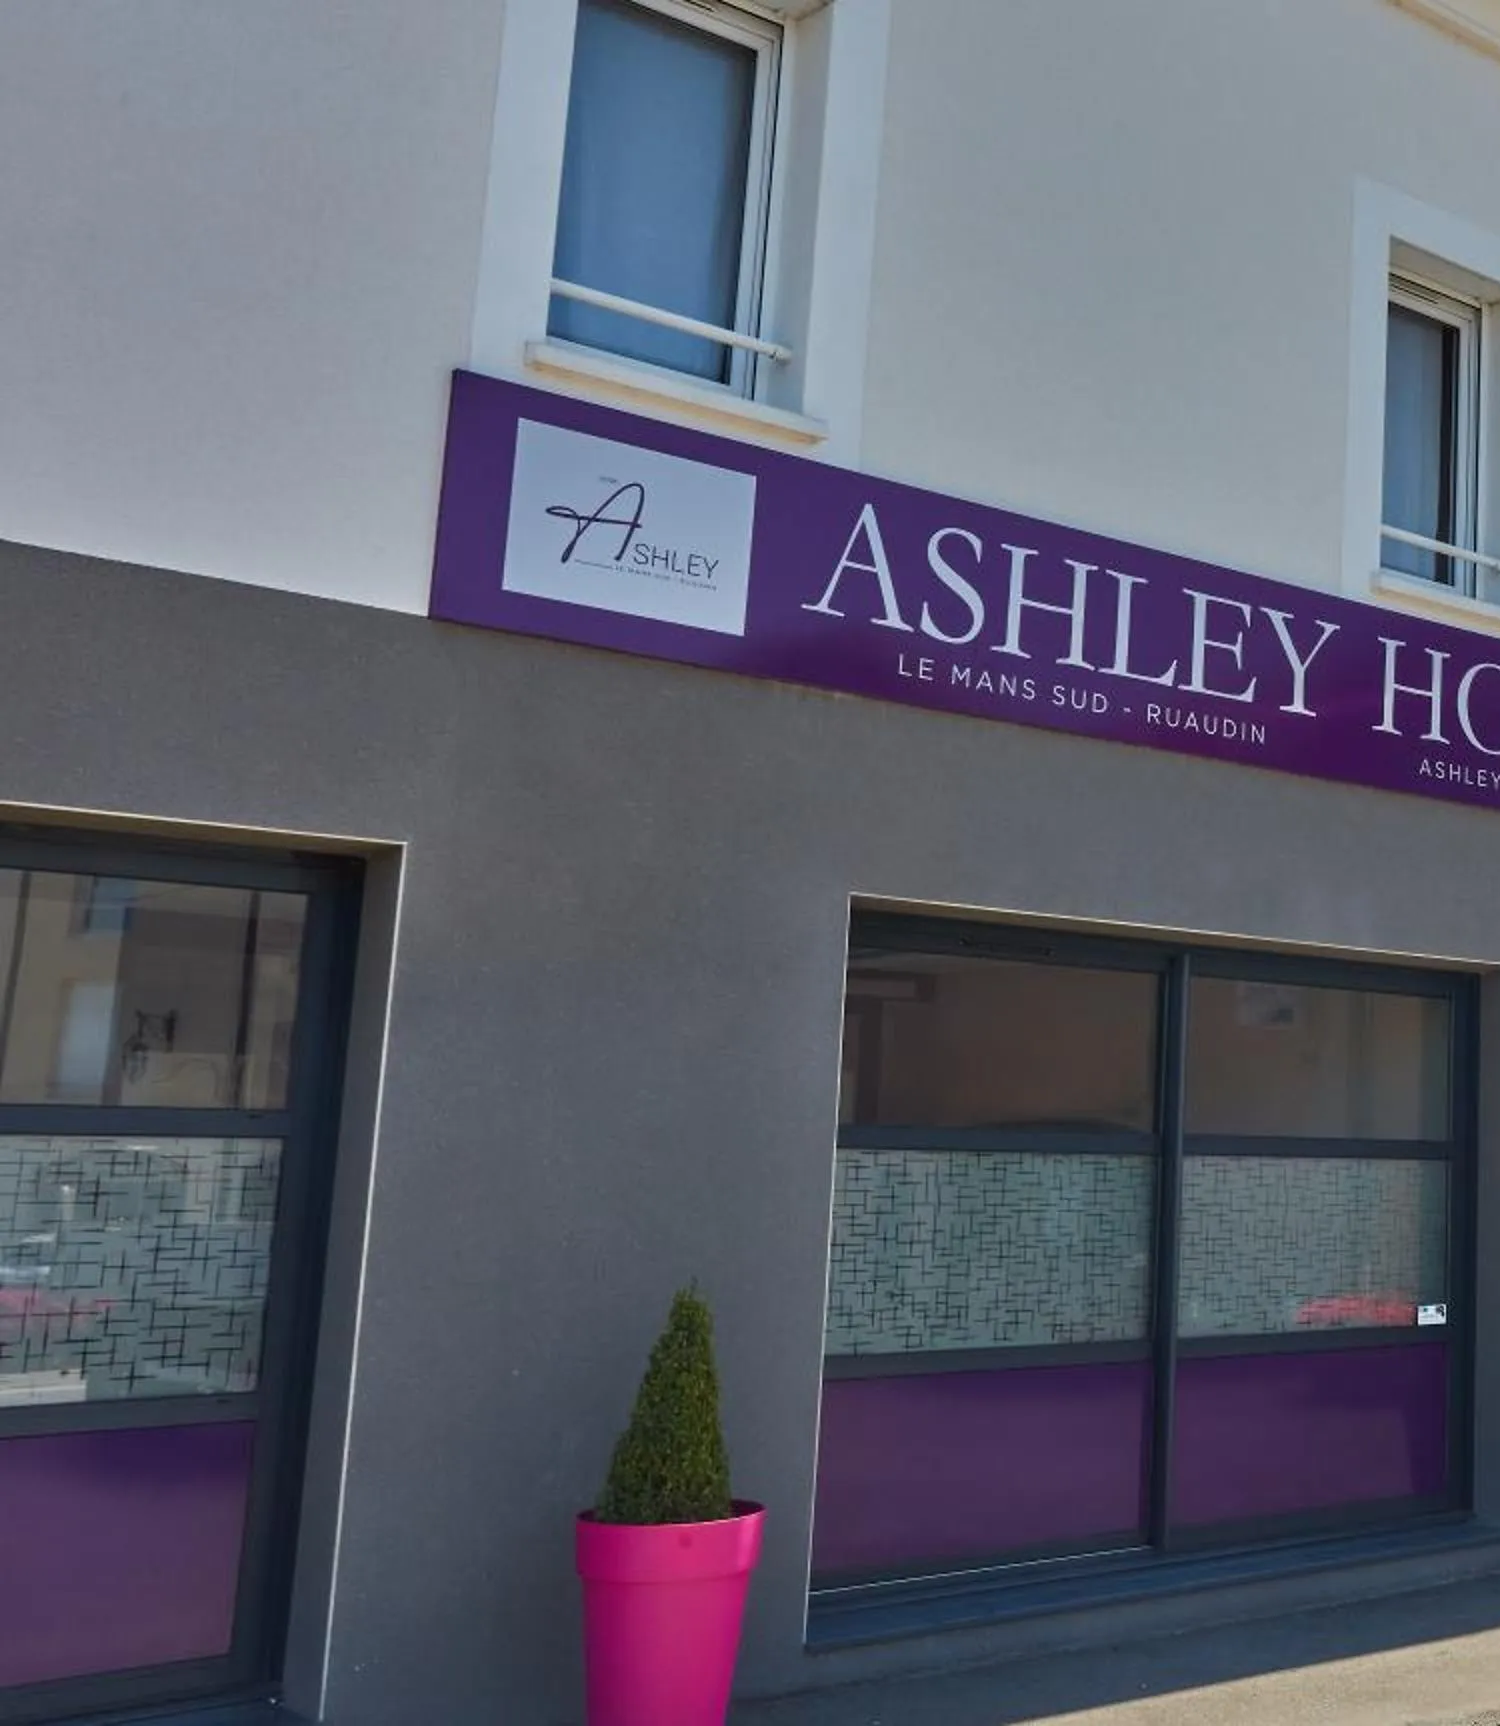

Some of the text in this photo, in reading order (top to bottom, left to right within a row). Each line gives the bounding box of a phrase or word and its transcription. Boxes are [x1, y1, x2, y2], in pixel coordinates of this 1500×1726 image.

[545, 482, 719, 579] ASHLEY
[801, 503, 1340, 717] ASHLEY
[898, 653, 935, 681] LE
[951, 664, 1036, 701] MANS
[1052, 685, 1108, 714] SUD
[1147, 704, 1266, 745] RUAUDIN
